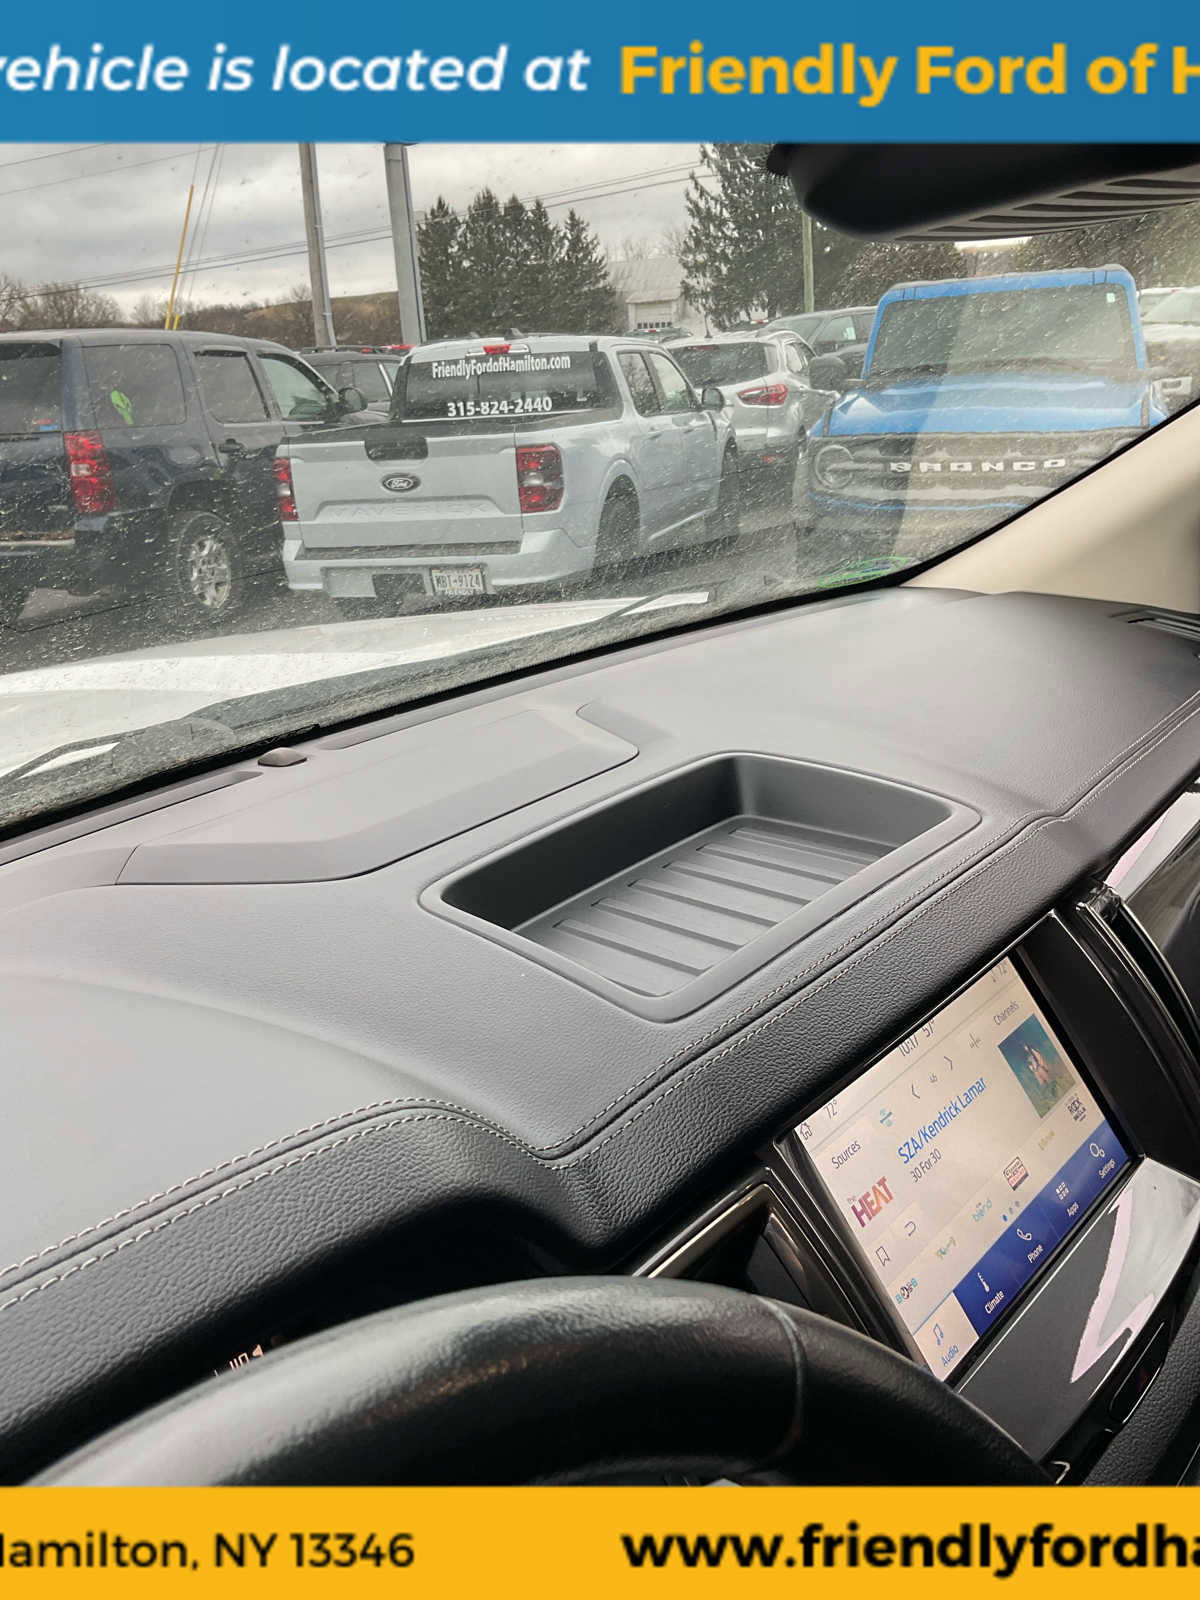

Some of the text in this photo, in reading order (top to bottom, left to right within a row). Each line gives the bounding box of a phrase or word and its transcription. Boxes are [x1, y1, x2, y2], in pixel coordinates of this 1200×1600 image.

[432, 355, 571, 380] FriendlyFordofHamilton.com
[447, 397, 553, 417] 315-824-2440
[890, 458, 1067, 473] BRONCO
[898, 1076, 987, 1164] SZA/Kendrick Lamar
[831, 1140, 862, 1170] Sources
[910, 1148, 942, 1182] 30 For 30
[1098, 1158, 1116, 1179] Settings
[851, 1175, 894, 1228] HEAT
[1067, 1202, 1080, 1217] Apps
[1027, 1244, 1044, 1264] Phone
[984, 1290, 1005, 1315] Climate
[941, 1345, 959, 1367] Audio
